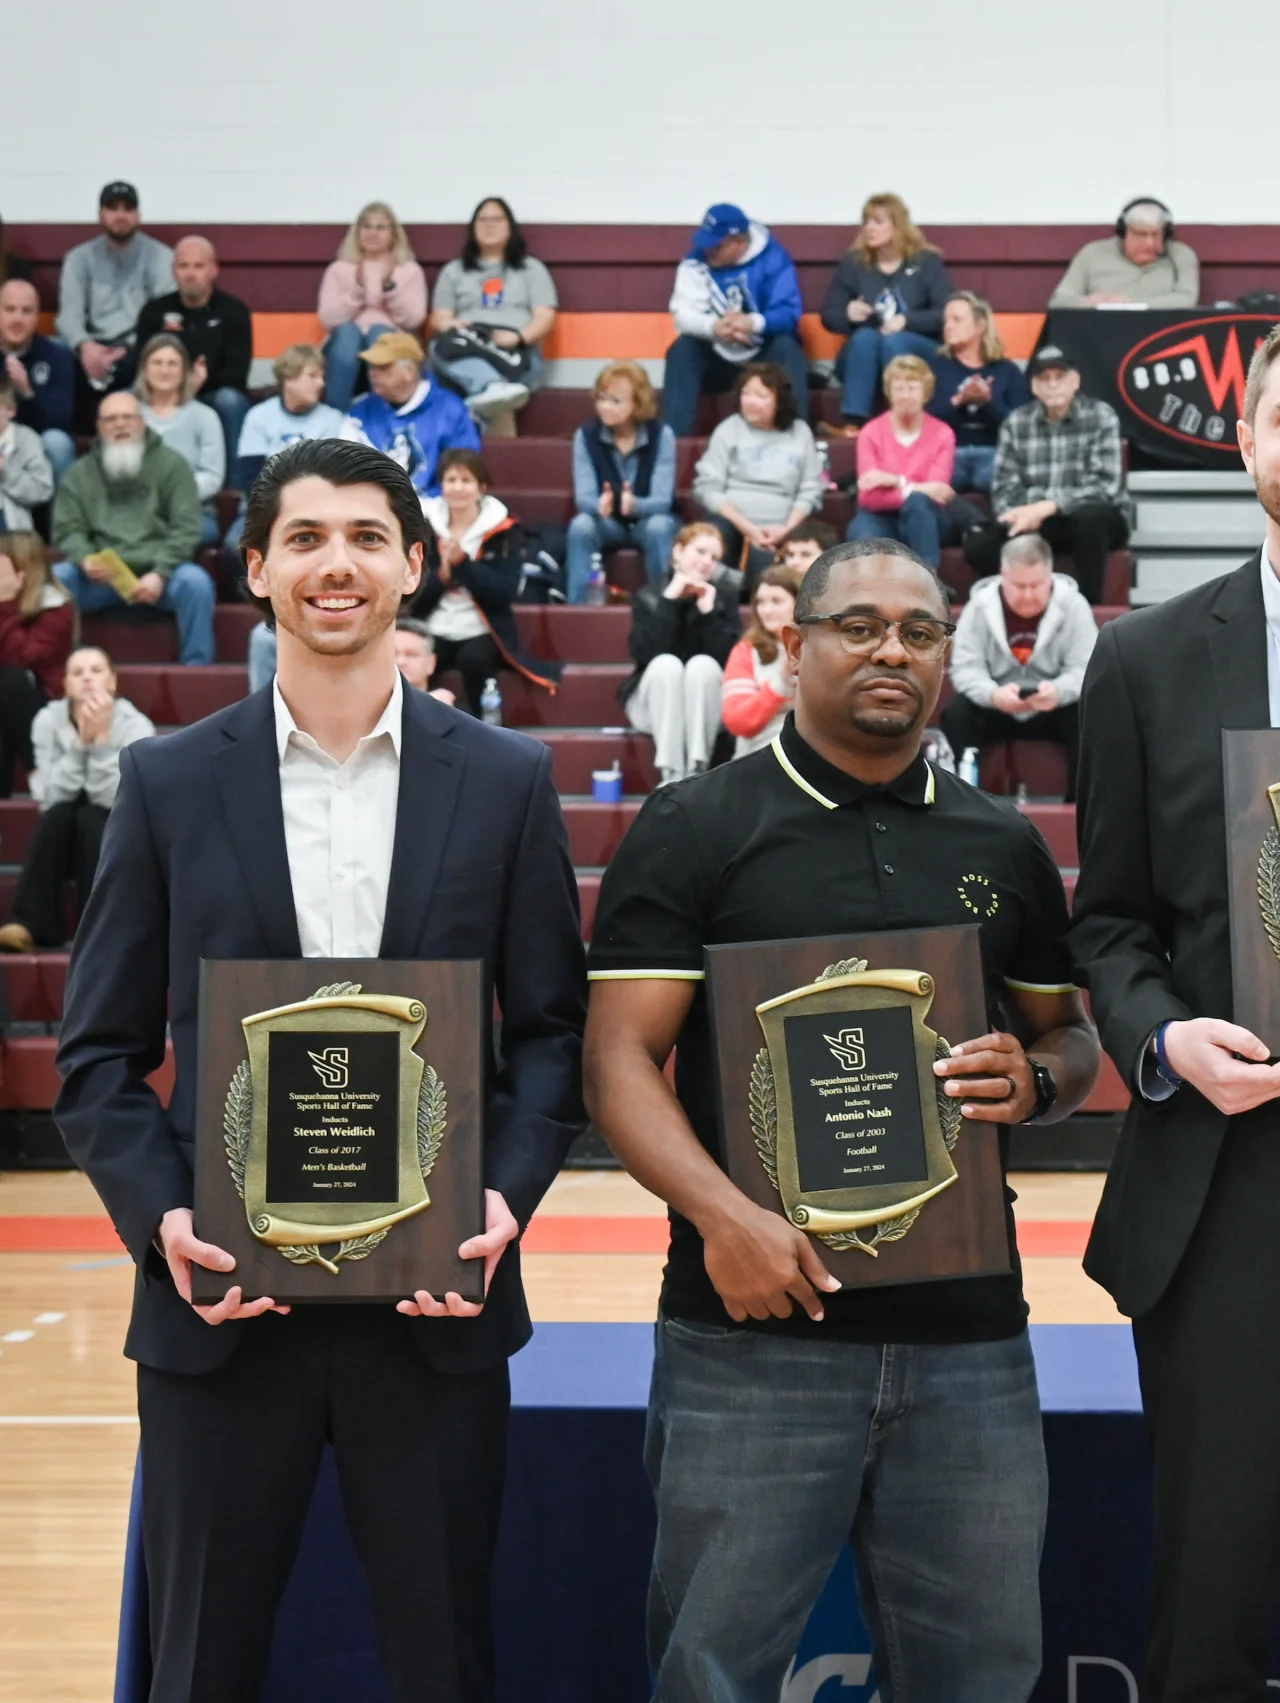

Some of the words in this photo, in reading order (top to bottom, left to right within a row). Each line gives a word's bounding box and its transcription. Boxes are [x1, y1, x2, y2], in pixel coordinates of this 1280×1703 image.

[961, 873, 990, 886] BOSS
[810, 1076, 858, 1087] Susquehanna
[860, 1072, 899, 1081] University
[819, 1087, 842, 1096] Sports
[845, 1084, 860, 1093] Hall
[872, 1083, 892, 1091] Fame
[289, 1092, 339, 1101] Susquehanna
[340, 1092, 380, 1101] University
[297, 1102, 321, 1111] Sports
[825, 1110, 864, 1122] Antonio
[867, 1108, 892, 1118] Nash
[294, 1127, 327, 1136] Steven
[330, 1127, 375, 1136] Weidlich
[847, 1145, 877, 1156] Football
